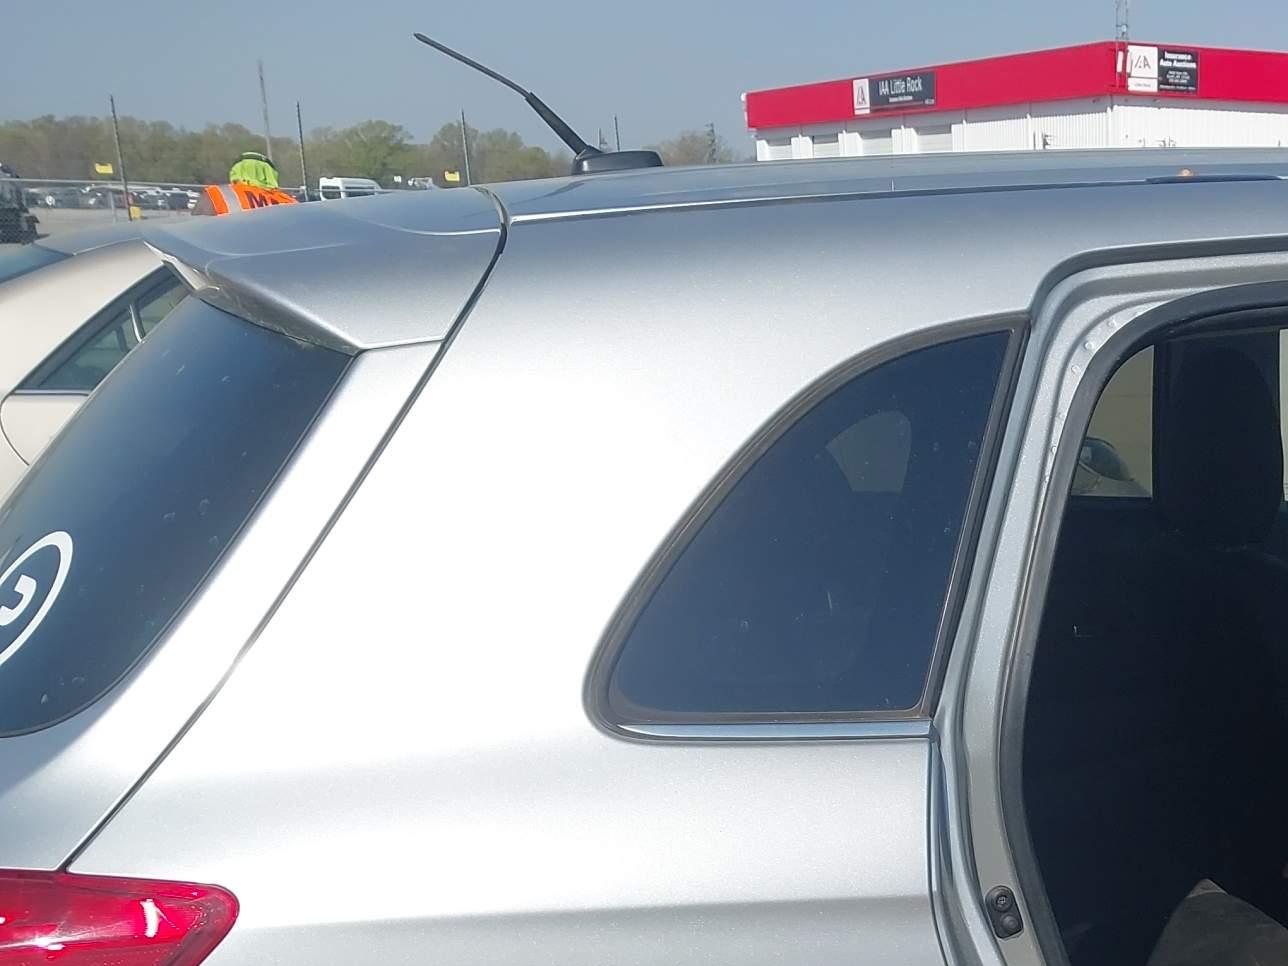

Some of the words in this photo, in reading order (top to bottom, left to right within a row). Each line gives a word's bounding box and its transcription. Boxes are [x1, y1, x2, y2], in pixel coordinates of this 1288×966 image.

[879, 80, 889, 95] IAA
[890, 78, 906, 95] Little
[906, 76, 922, 92] Rock
